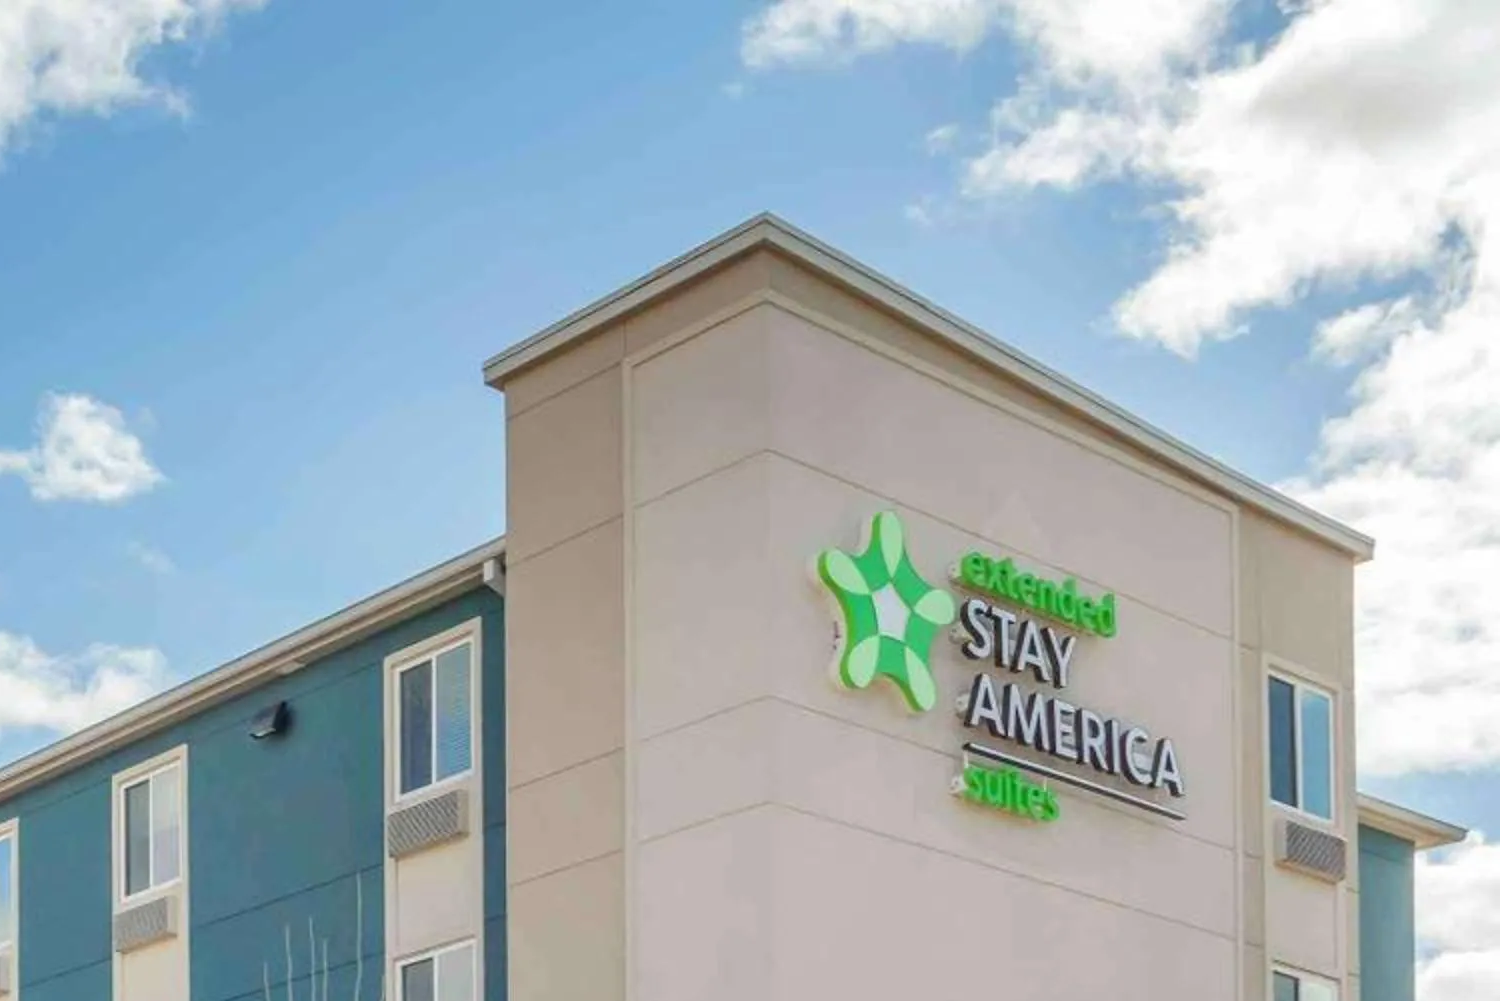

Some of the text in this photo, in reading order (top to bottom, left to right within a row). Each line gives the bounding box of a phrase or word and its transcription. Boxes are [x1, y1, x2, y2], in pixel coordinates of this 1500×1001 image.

[961, 552, 1117, 638] extended
[960, 599, 1077, 689] STAY
[964, 672, 1186, 797] AMERICA
[964, 765, 1061, 821] suites
